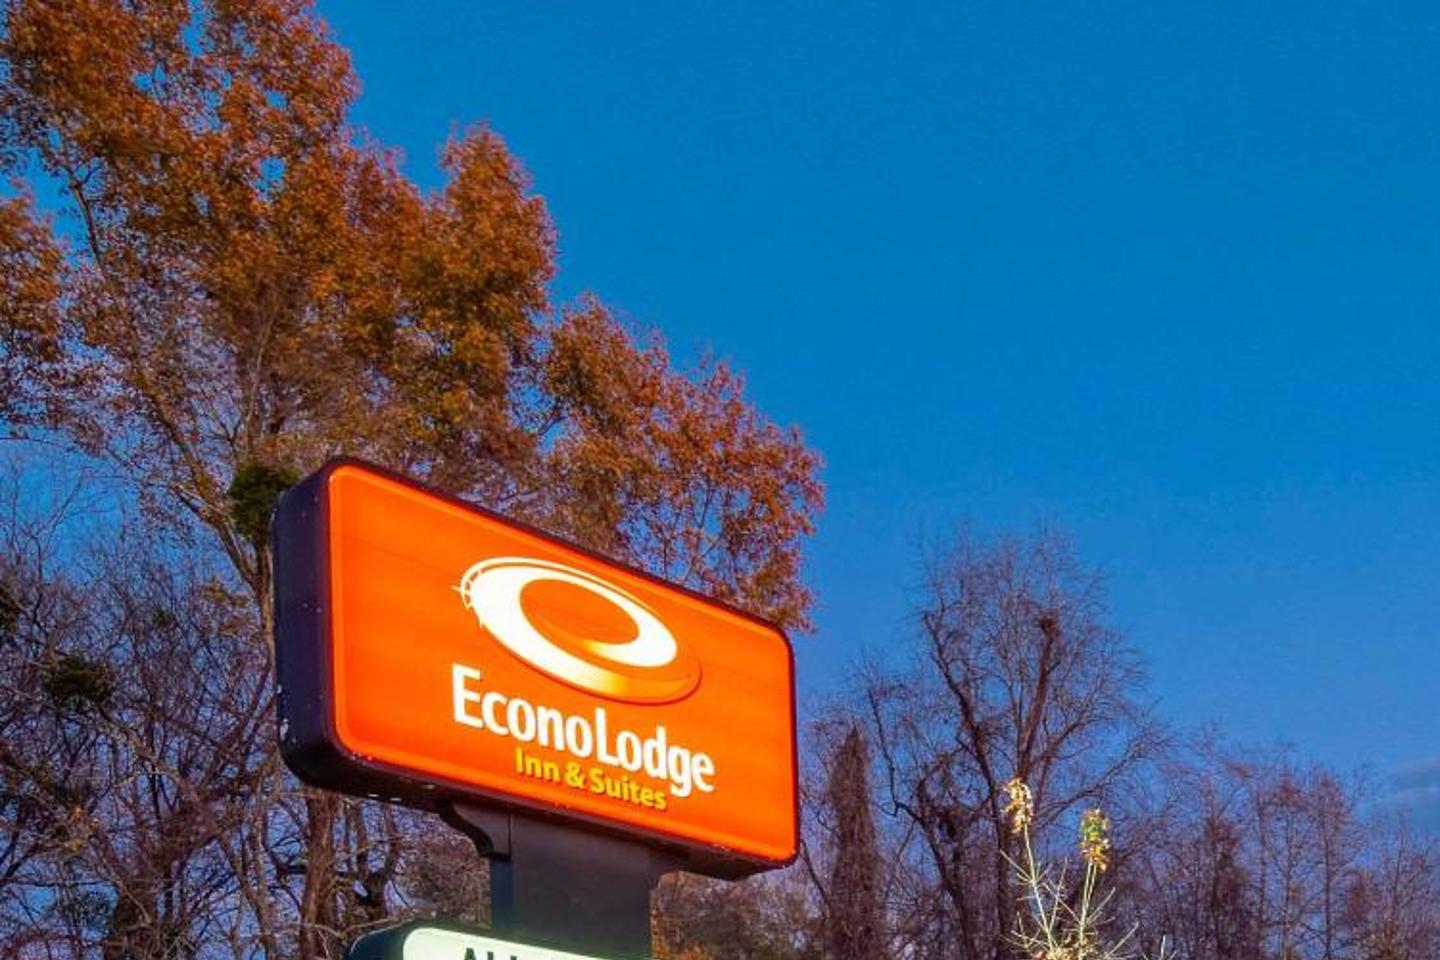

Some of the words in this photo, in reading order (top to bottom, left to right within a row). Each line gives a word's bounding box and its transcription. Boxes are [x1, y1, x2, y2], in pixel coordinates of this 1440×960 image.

[516, 747, 560, 783] Inn
[565, 760, 585, 789] &
[590, 767, 668, 811] Suites
